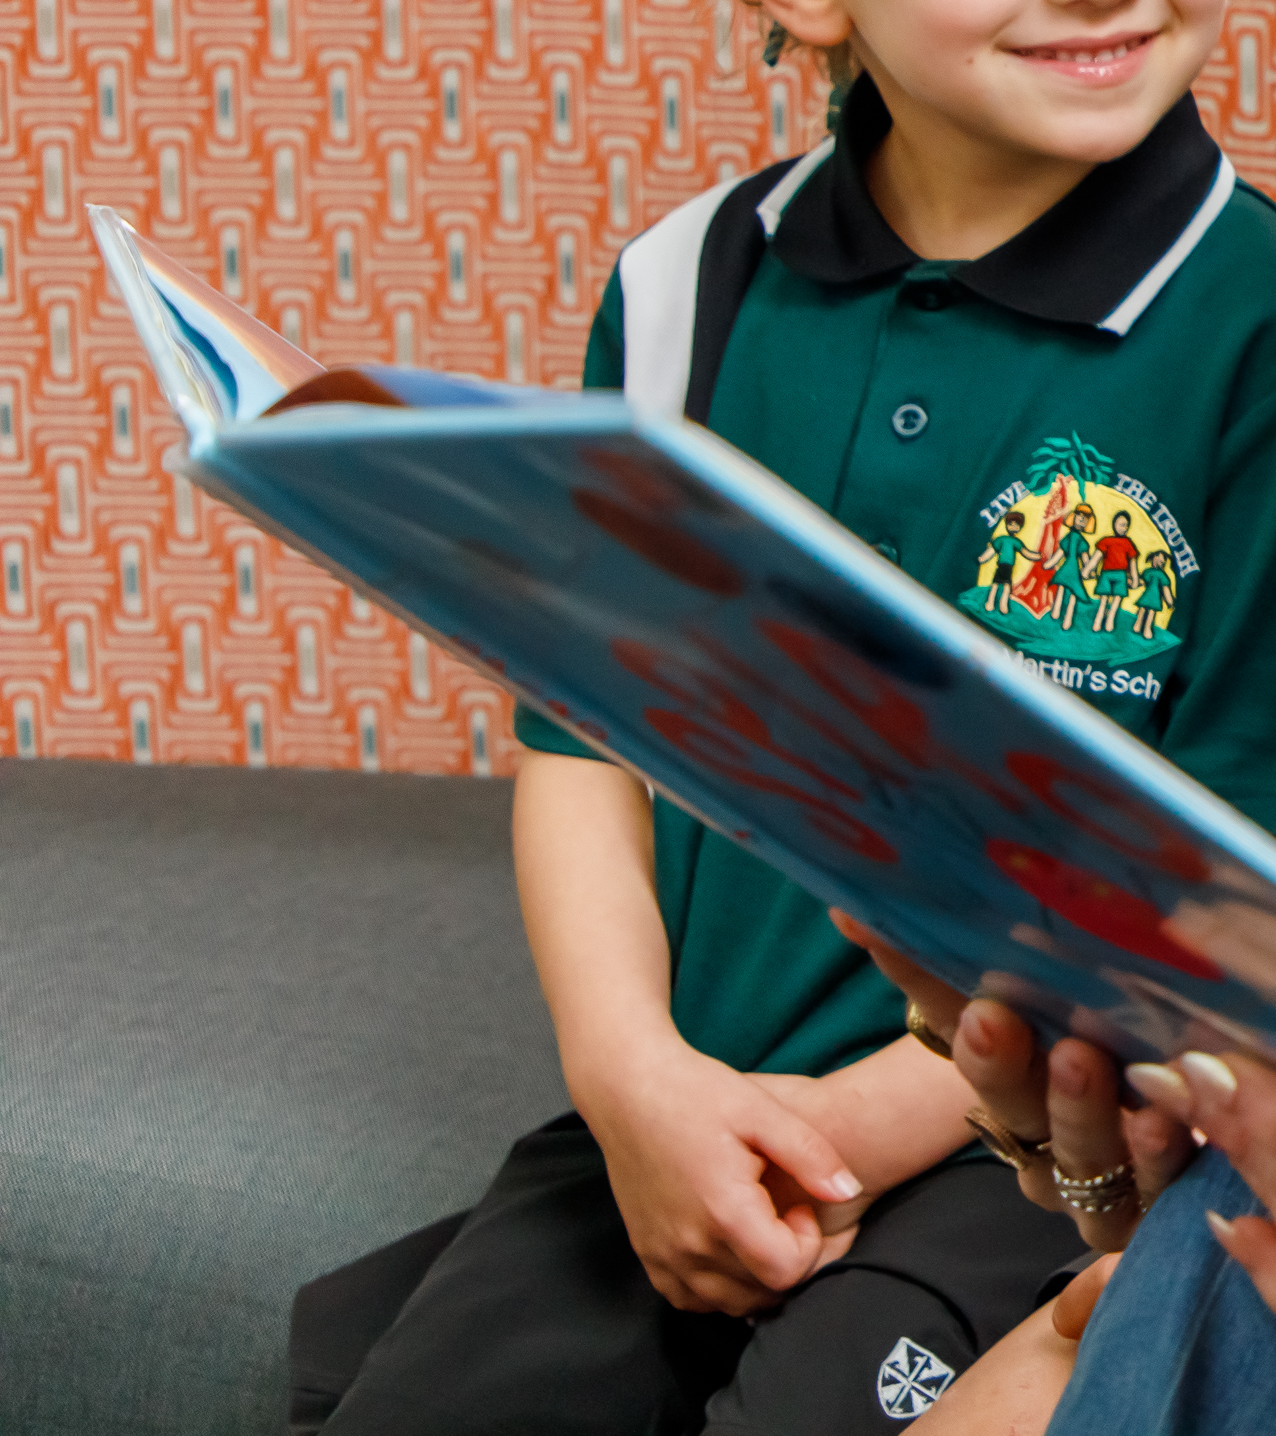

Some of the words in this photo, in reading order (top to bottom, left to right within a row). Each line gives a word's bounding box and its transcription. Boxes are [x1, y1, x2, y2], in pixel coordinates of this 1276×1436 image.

[979, 480, 1031, 529] LIVE
[1113, 473, 1158, 509] THE
[1151, 502, 1200, 578] TRUTH
